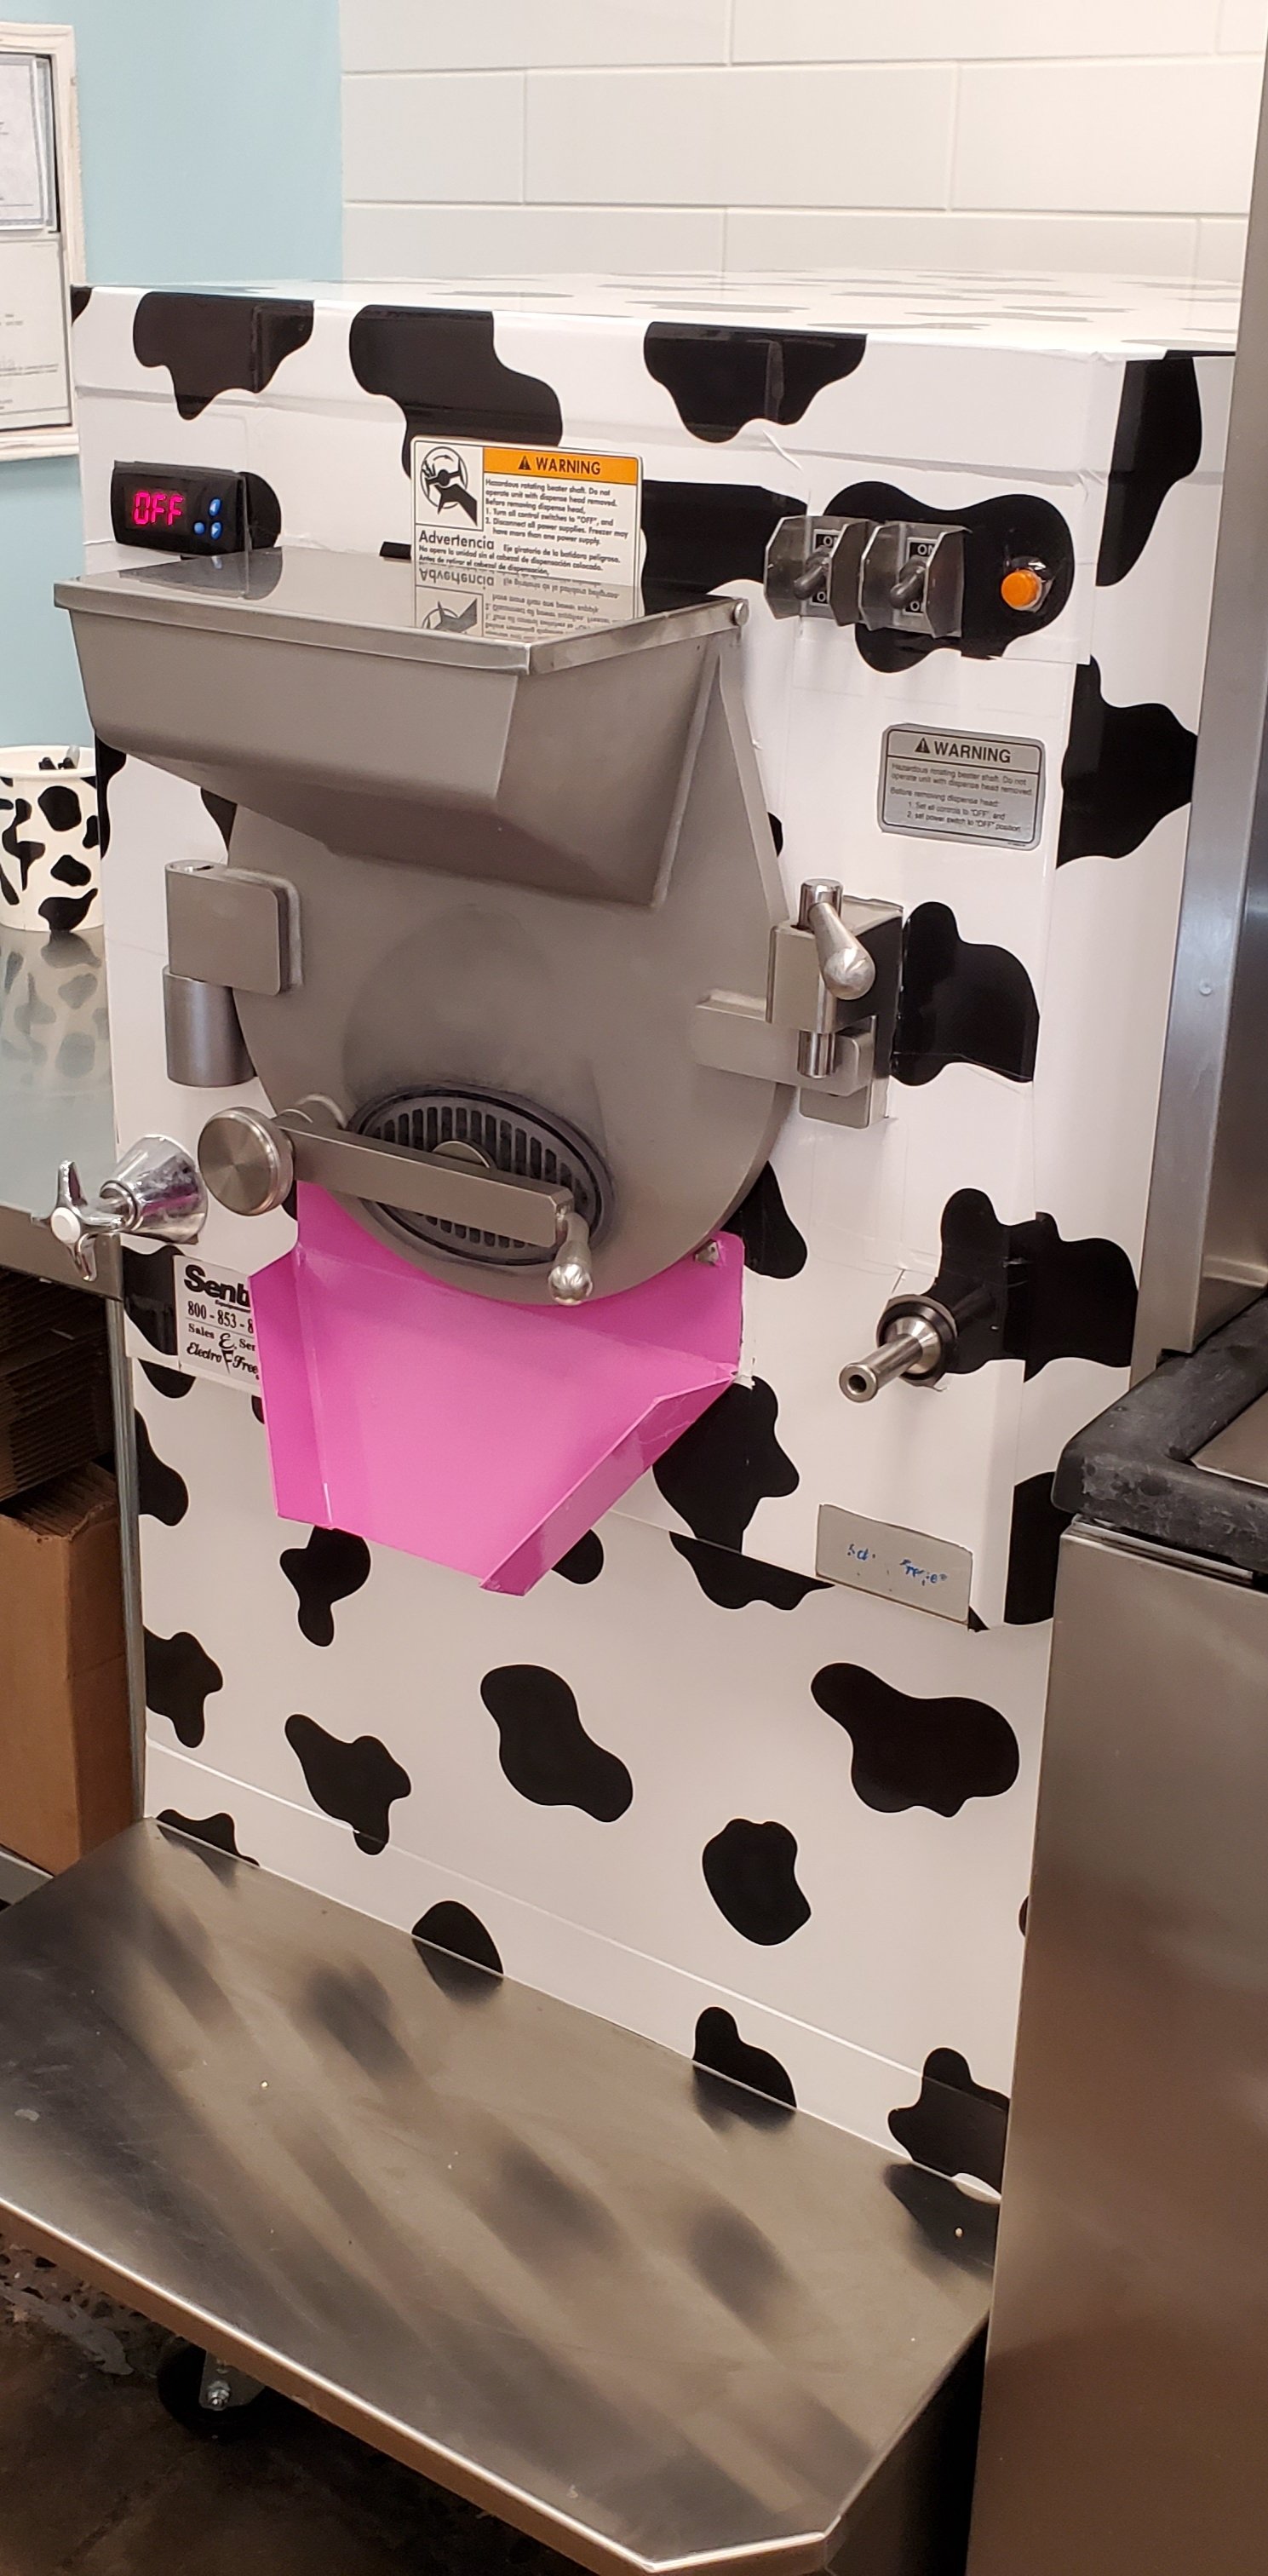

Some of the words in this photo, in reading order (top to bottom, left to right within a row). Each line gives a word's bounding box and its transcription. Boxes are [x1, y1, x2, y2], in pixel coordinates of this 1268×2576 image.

[536, 456, 600, 475] WARNING
[485, 479, 519, 488] Hazardous
[520, 482, 545, 492] rotating
[485, 497, 505, 506] Before
[507, 501, 536, 510] removing
[538, 503, 565, 512] dispense
[540, 493, 567, 502] dispense
[569, 495, 585, 503] head
[134, 490, 184, 526] OFF
[541, 513, 567, 521] switches
[493, 518, 526, 527] Disconnect
[588, 526, 612, 535] Freezer
[614, 531, 628, 539] may
[419, 530, 495, 550] Advertencia
[456, 549, 477, 557] unidad
[934, 740, 1011, 763] WARNING
[1002, 775, 1013, 784] Do
[187, 1301, 207, 1320] 800
[217, 1309, 237, 1329] 853
[247, 1319, 255, 1334] 8
[188, 1323, 215, 1339] Sales
[186, 1342, 222, 1363] Electro
[232, 1355, 259, 1380] Free
